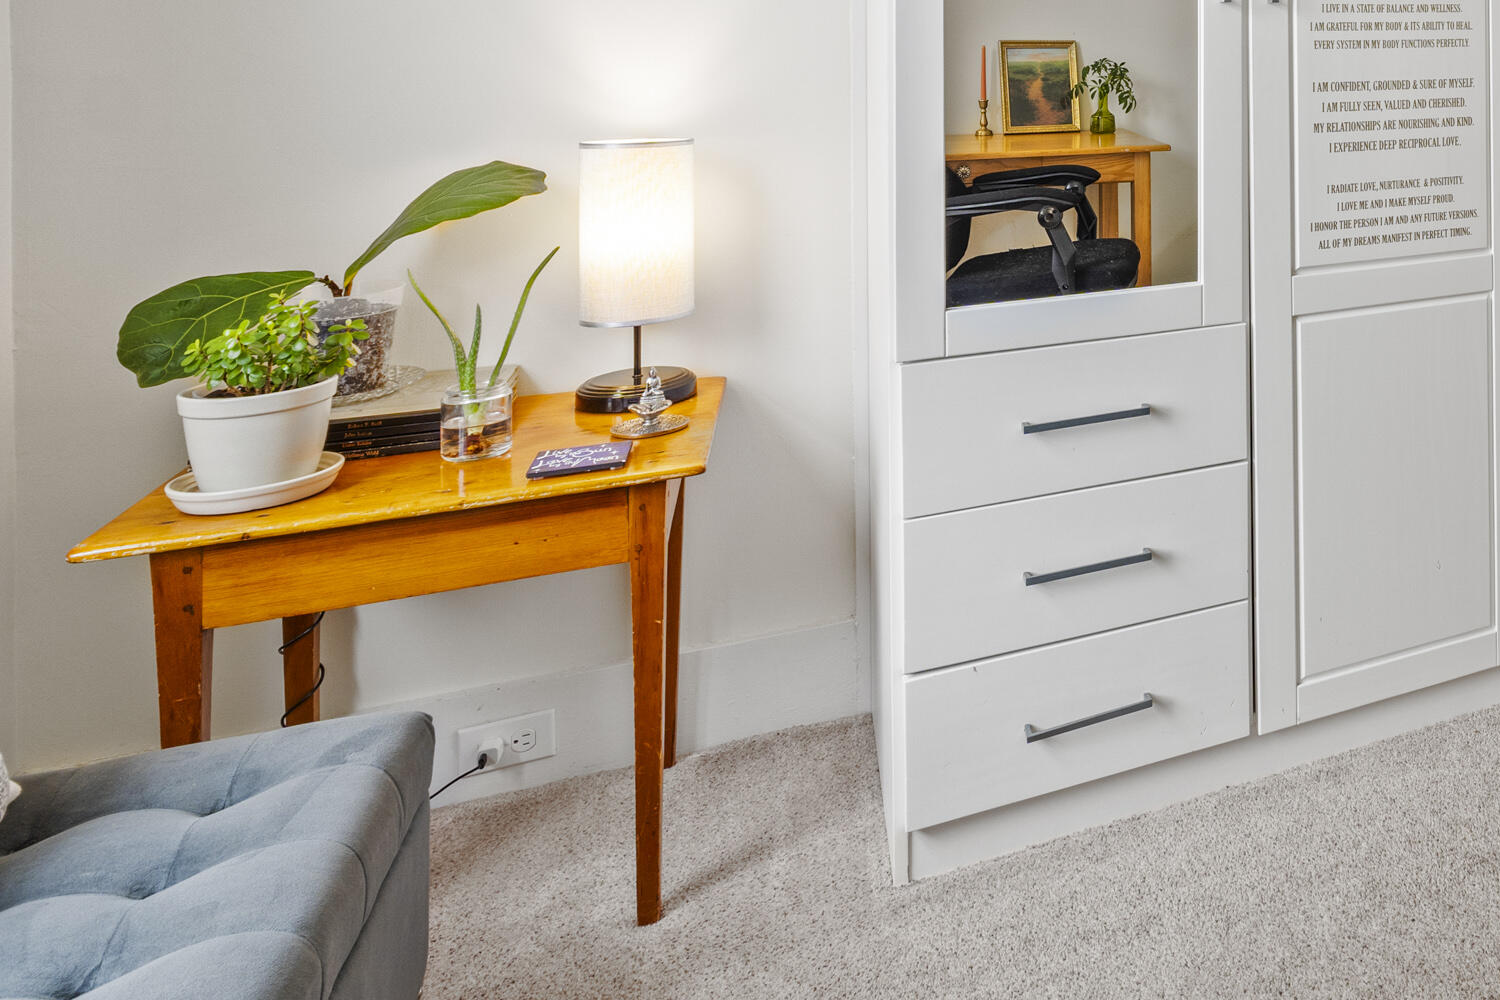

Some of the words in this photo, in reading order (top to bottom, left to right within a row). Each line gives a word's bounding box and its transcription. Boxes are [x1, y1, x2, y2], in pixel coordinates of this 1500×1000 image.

[1317, 82, 1328, 92] AM
[1373, 80, 1410, 91] GROUNDED
[1420, 80, 1437, 89] SURE
[1438, 78, 1447, 89] OF
[1314, 122, 1324, 133] MY
[1327, 120, 1381, 133] RELATIONSHIPS
[1383, 120, 1396, 130] ARE
[1399, 118, 1439, 130] NOURISHING
[1441, 118, 1455, 128] AND
[1334, 140, 1377, 153] EXPERIENCE
[1379, 140, 1397, 151] DEEP
[1399, 138, 1441, 149] RECIPROCAL
[1331, 182, 1359, 194] RADIATE
[1380, 178, 1420, 191] NURTURANCE
